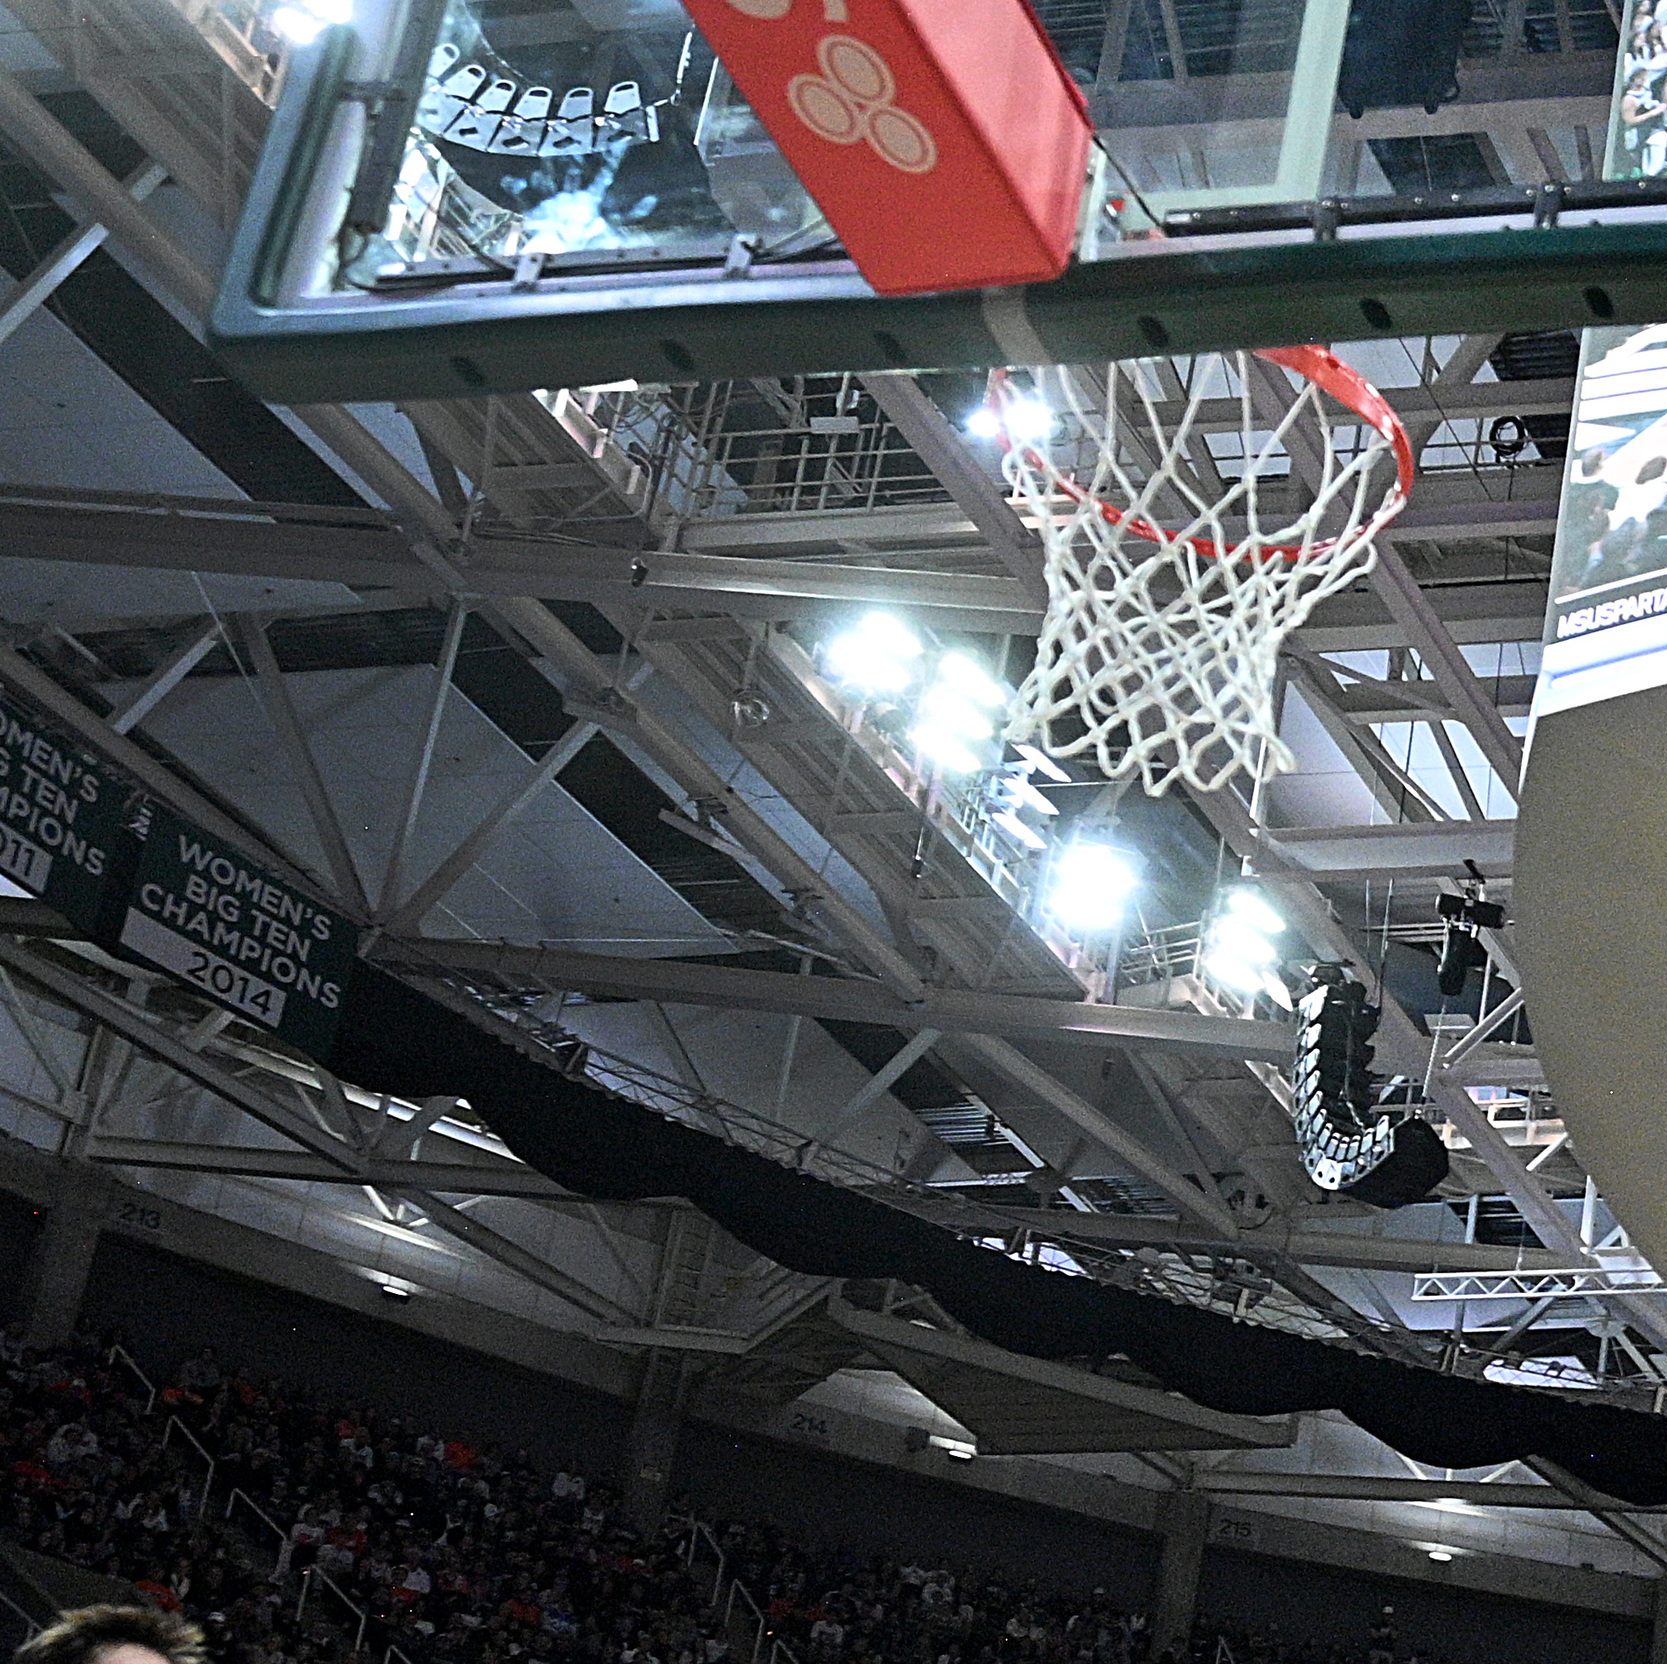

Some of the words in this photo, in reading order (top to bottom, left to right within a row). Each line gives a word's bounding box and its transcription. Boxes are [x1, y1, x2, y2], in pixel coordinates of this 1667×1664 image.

[0, 711, 99, 804] MEN'S
[20, 765, 77, 824] TEN
[177, 834, 332, 941] WOMEN'S
[185, 874, 242, 923] BIG
[250, 910, 311, 962] TEN
[140, 883, 341, 1009] CHAMPIONS
[188, 951, 272, 1015] 2014
